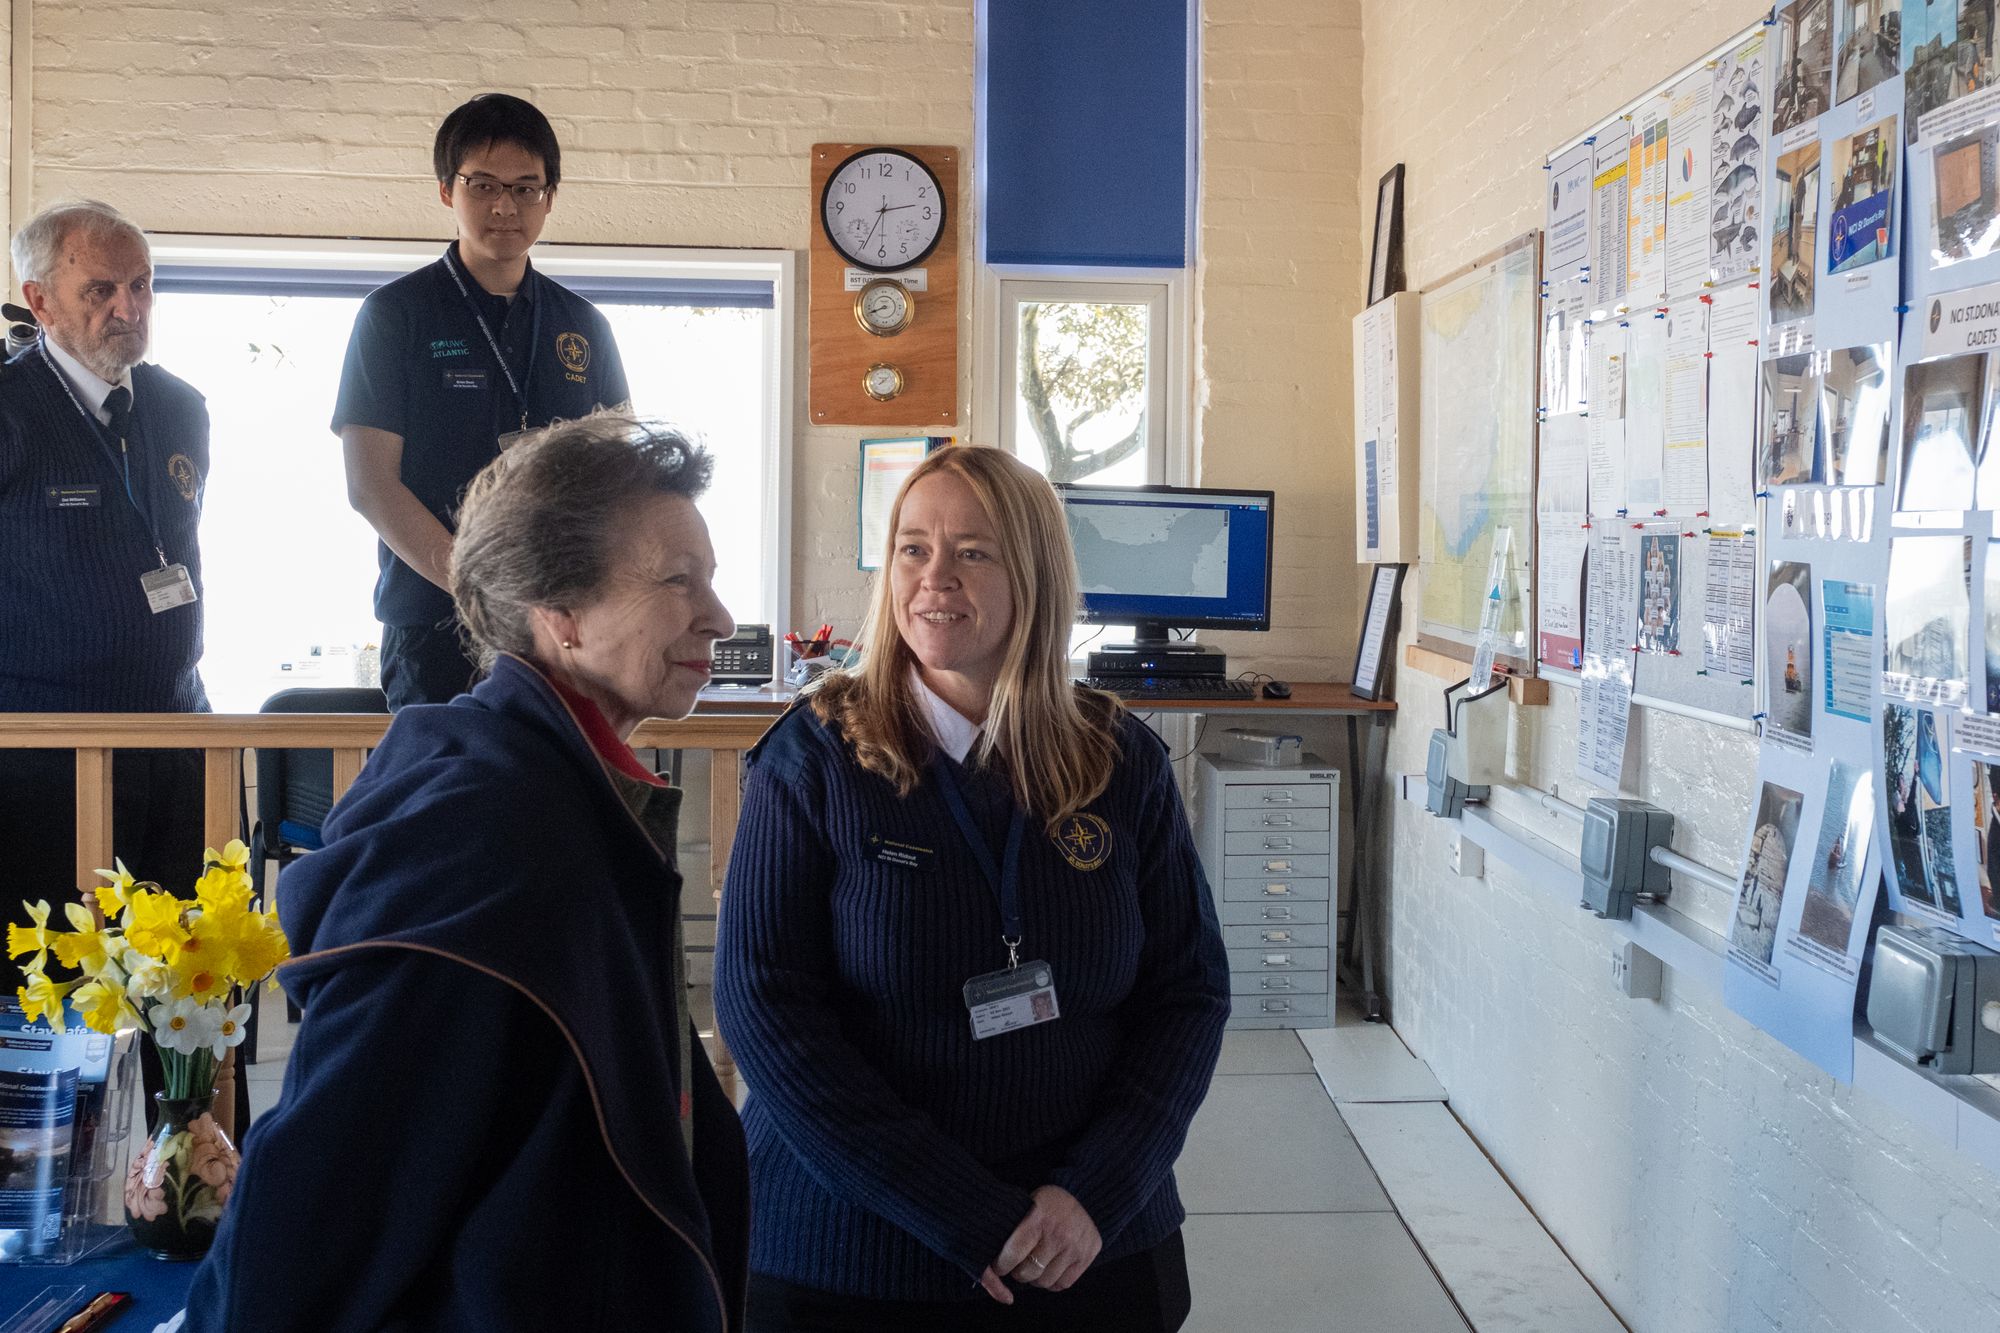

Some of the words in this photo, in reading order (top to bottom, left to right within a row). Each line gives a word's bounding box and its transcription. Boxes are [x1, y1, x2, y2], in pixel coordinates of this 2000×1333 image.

[861, 168, 870, 179] 11
[878, 163, 893, 177] 12
[844, 182, 856, 194] 10
[918, 187, 926, 198] 2
[835, 201, 845, 215] 9
[922, 206, 932, 220] 3
[858, 240, 865, 251] 7
[878, 245, 887, 258] 6
[899, 243, 907, 253] 5
[1950, 308, 1964, 324] NCI
[1967, 328, 1997, 347] CADETS
[446, 340, 466, 348] UWC
[433, 348, 469, 359] ATLANTIC
[565, 372, 587, 384] CADET
[66, 1025, 88, 1035] afe
